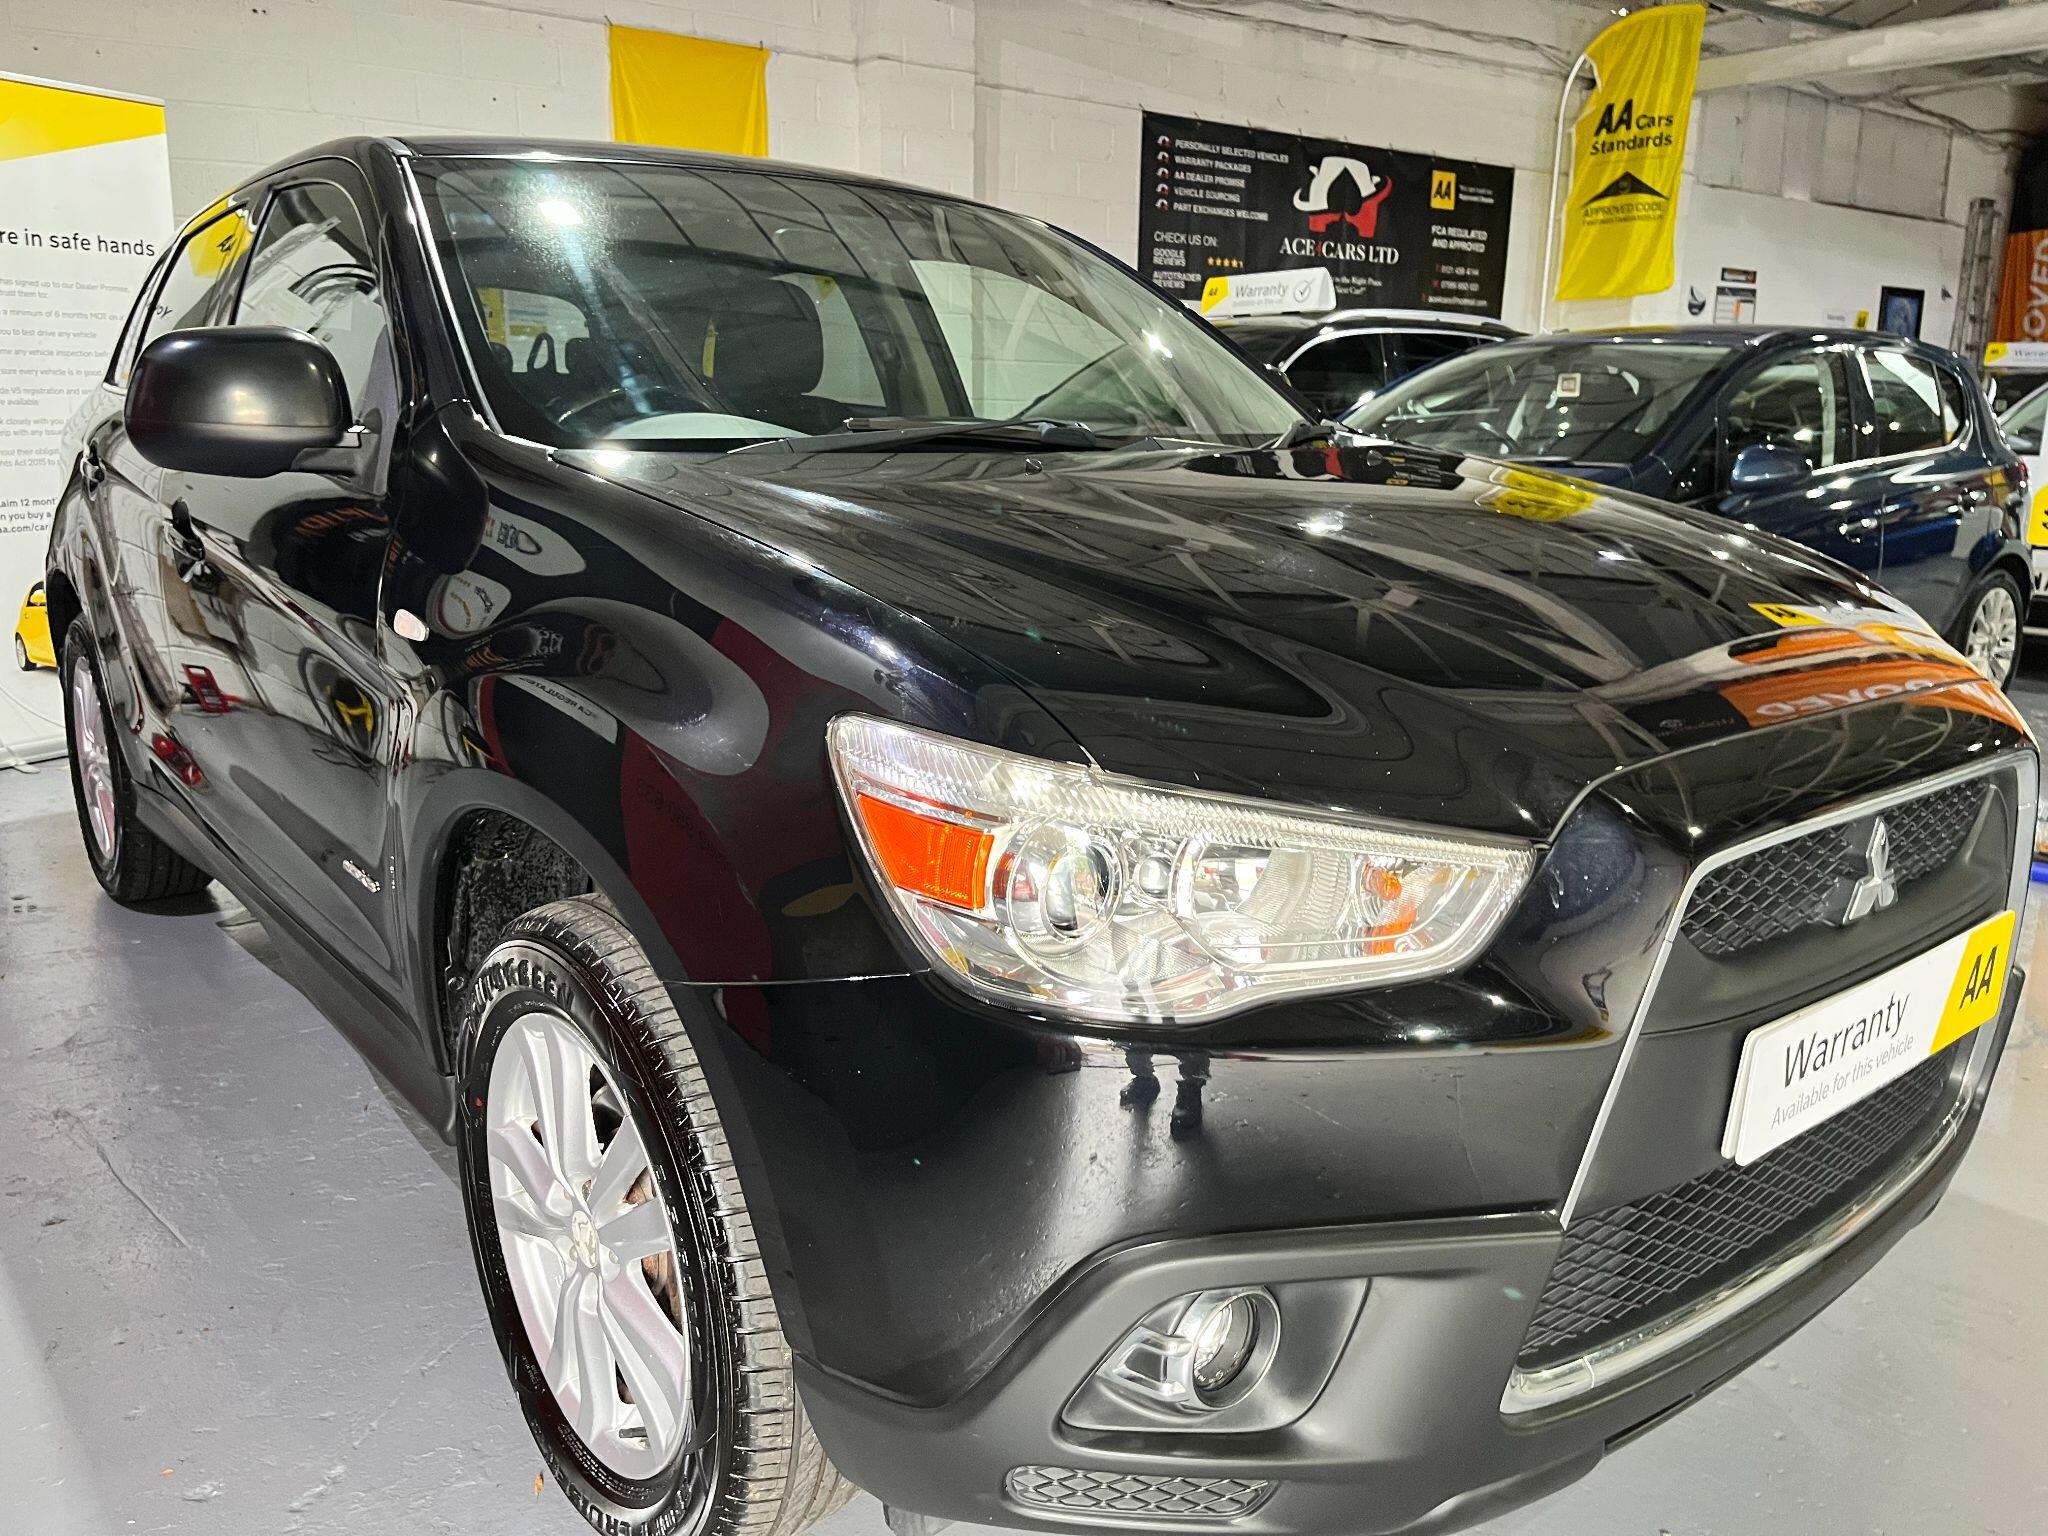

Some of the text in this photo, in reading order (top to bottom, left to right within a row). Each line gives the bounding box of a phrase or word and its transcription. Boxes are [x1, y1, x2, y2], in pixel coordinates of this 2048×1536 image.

[1594, 98, 1674, 137] AA Cars
[1590, 131, 1673, 156] Standards
[1221, 145, 1256, 159] SELECTED
[1257, 150, 1289, 164] VEHICLES
[1174, 154, 1251, 174] WARRANTY PACKAGES
[1186, 172, 1213, 184] DEALER
[1174, 186, 1204, 198] VEHICLE
[1433, 179, 1452, 201] AA
[1173, 202, 1192, 212] PART
[1193, 204, 1235, 217] EXCHANGES
[24, 228, 42, 247] in
[49, 233, 91, 251] safe
[97, 235, 155, 256] hands
[1154, 231, 1187, 244] CHECK
[1188, 234, 1201, 246] US
[1153, 247, 1185, 258] GOOGLE
[1279, 237, 1399, 264] ACE CARS LTD
[1153, 256, 1186, 267] REVIEWS
[1153, 271, 1201, 283] AUTOTRADER
[1235, 281, 1289, 299] Warranty
[21, 498, 30, 507] 12
[9, 513, 26, 521] you
[27, 511, 44, 520] buy
[1959, 943, 1999, 1010] AA
[1784, 991, 1911, 1088] Warranty
[1770, 1034, 1915, 1130] Available for this vehicle
